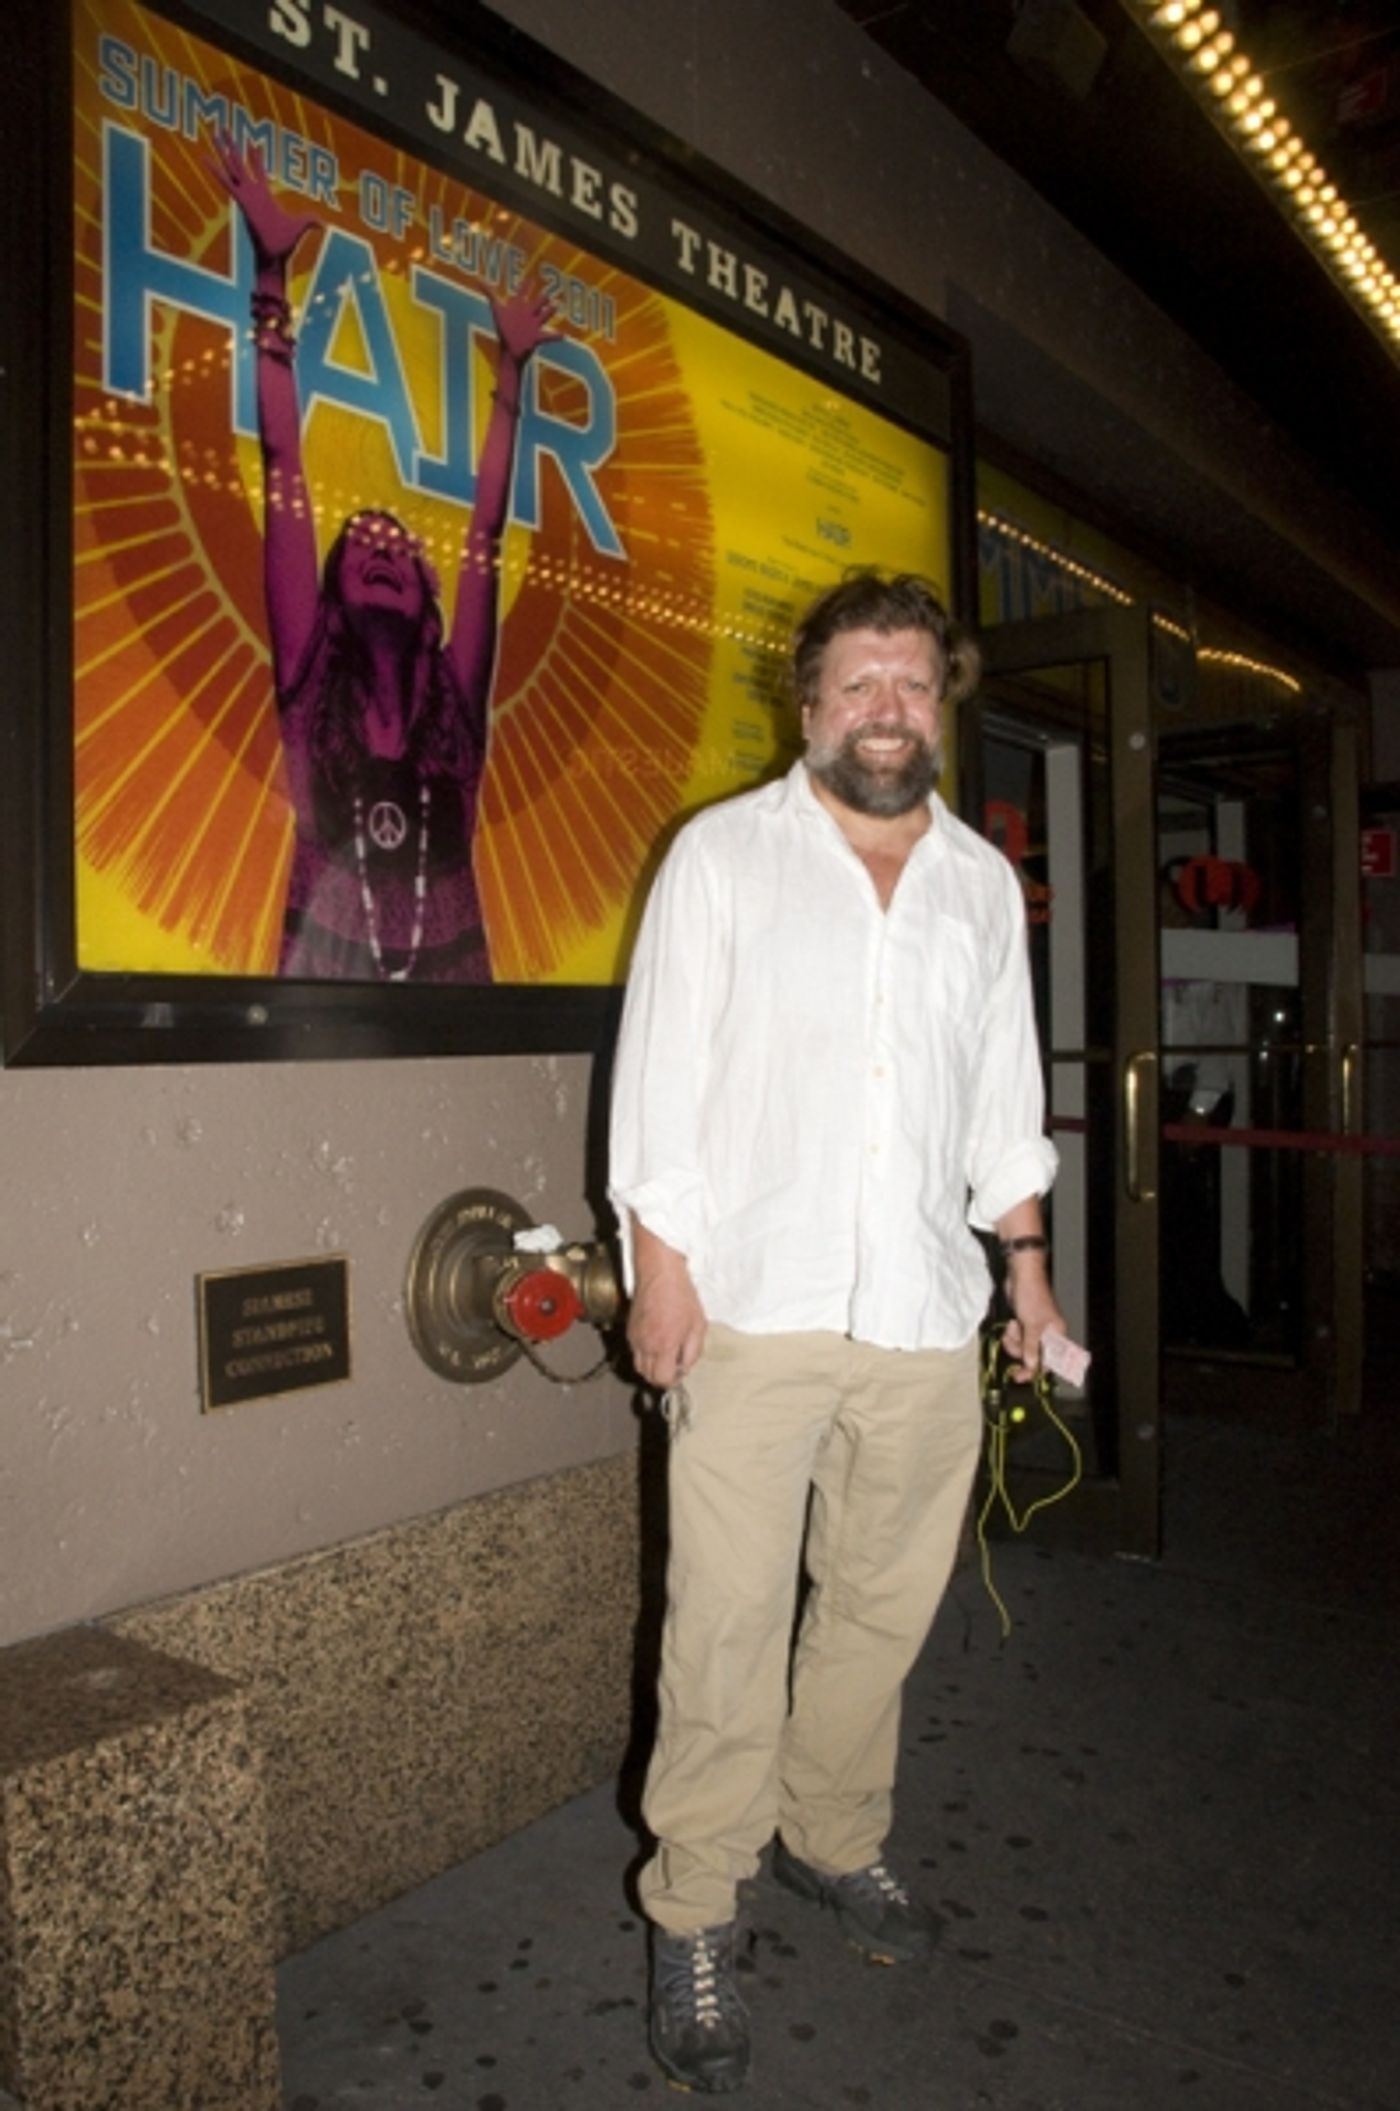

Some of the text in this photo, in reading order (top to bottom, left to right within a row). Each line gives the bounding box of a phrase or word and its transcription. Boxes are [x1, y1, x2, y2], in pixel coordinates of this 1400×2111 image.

[98, 32, 618, 345] SUMMER OF LOVE 2011
[101, 116, 629, 563] HAIR
[269, 0, 881, 385] ST. JAMES THEATRE
